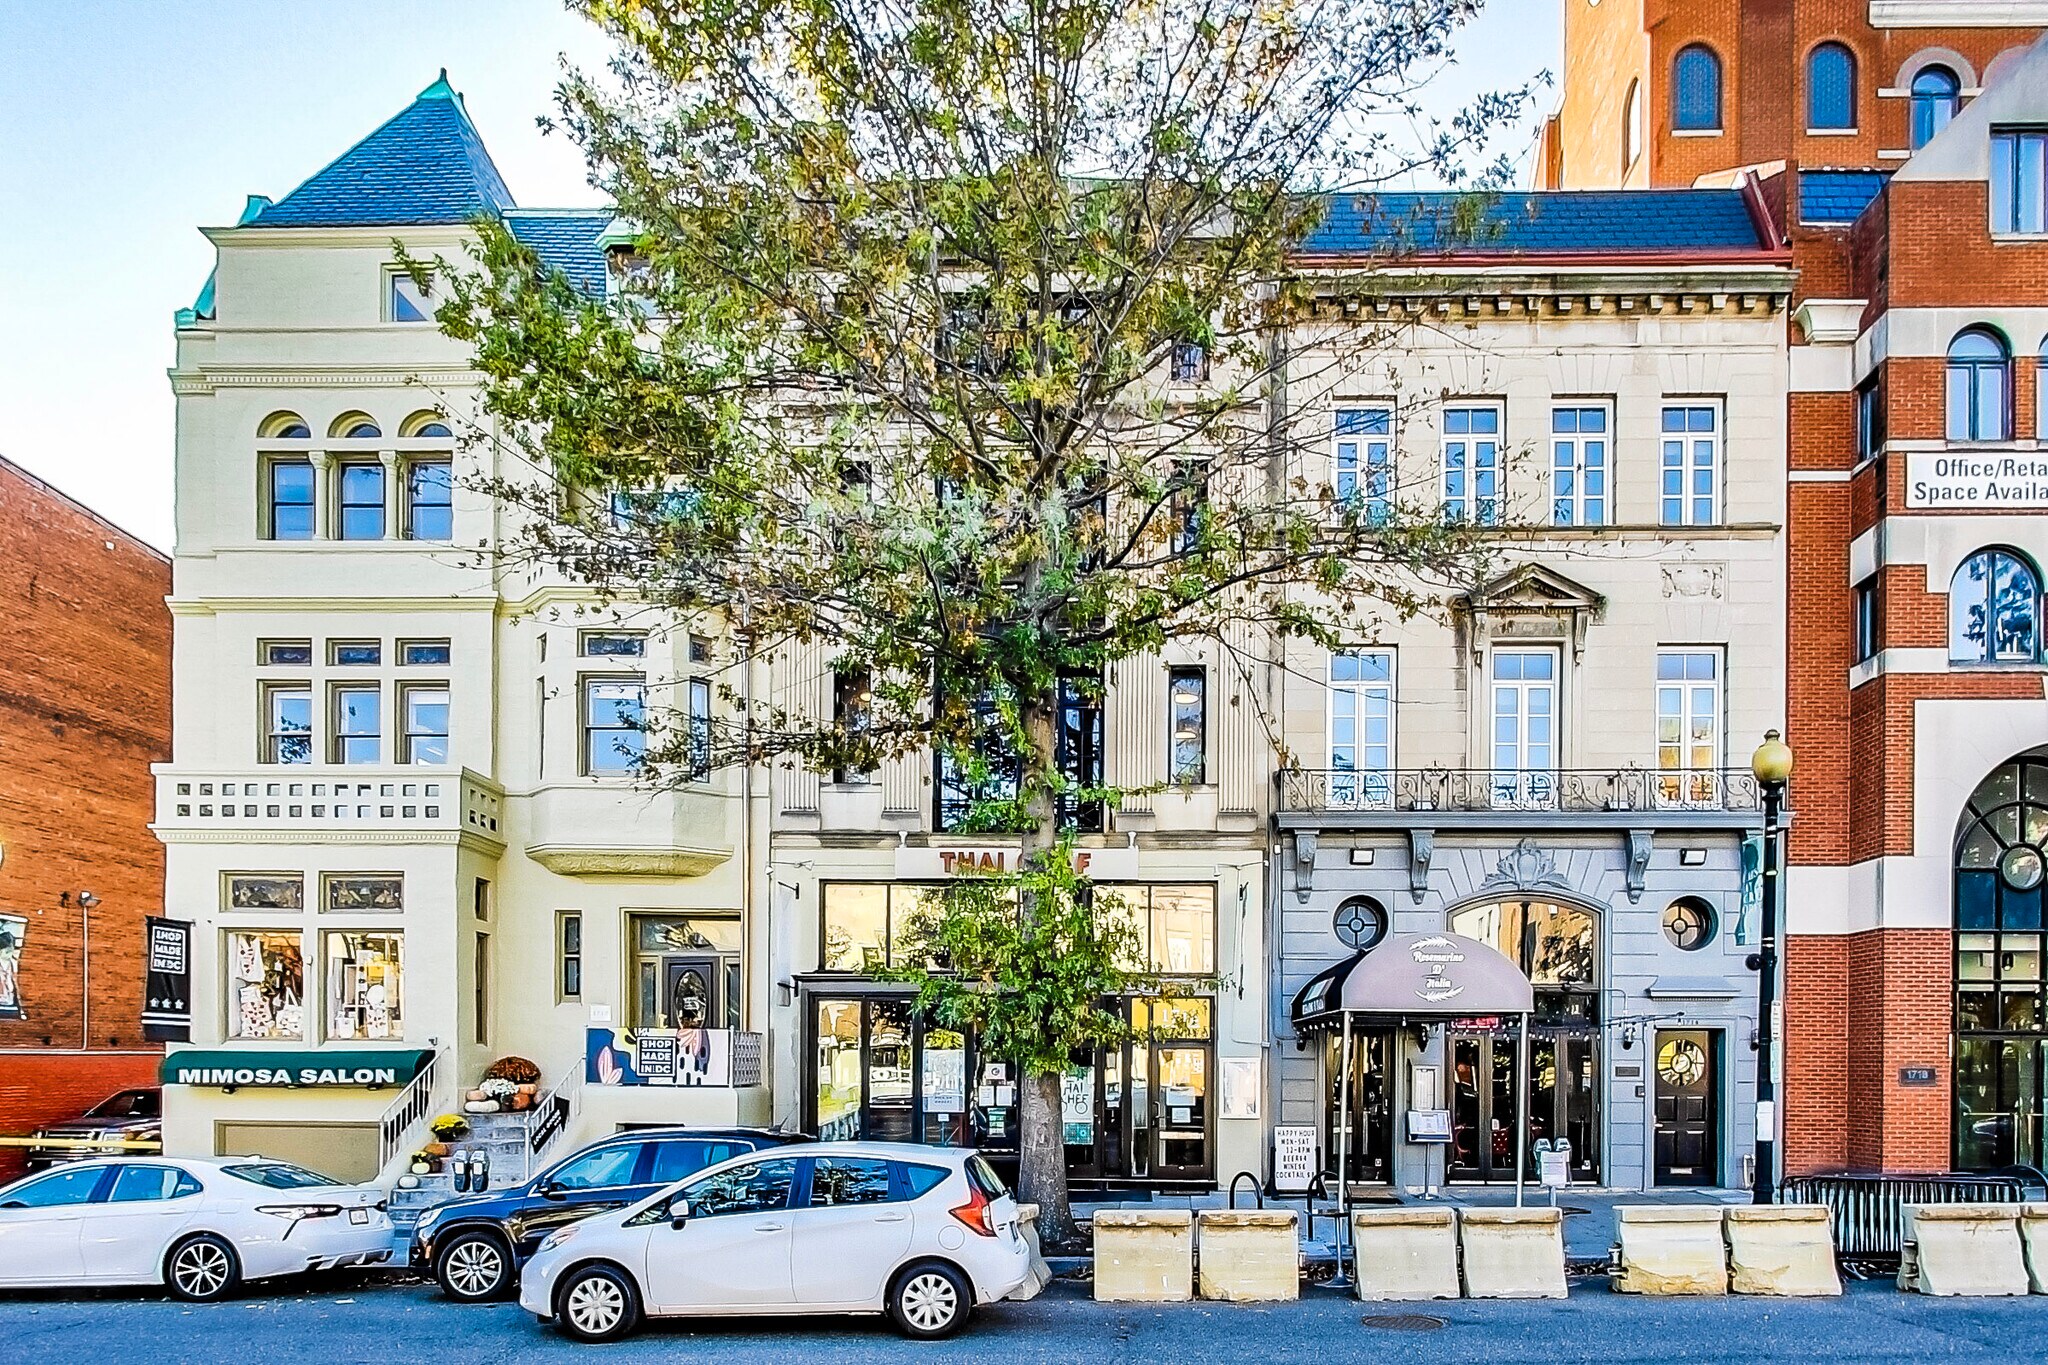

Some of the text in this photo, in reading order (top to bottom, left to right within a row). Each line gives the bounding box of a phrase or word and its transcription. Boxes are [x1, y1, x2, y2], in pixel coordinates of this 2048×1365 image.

[1935, 459, 2048, 479] Office/Reta
[1914, 482, 2048, 505] Space Availa
[940, 852, 1004, 873] THAI
[155, 930, 182, 941] SHOP
[154, 944, 182, 956] MADE
[641, 1040, 672, 1048] SHOP
[641, 1052, 671, 1061] MADE
[655, 1064, 671, 1073] DC
[178, 1068, 395, 1084] MIMOSA SALON
